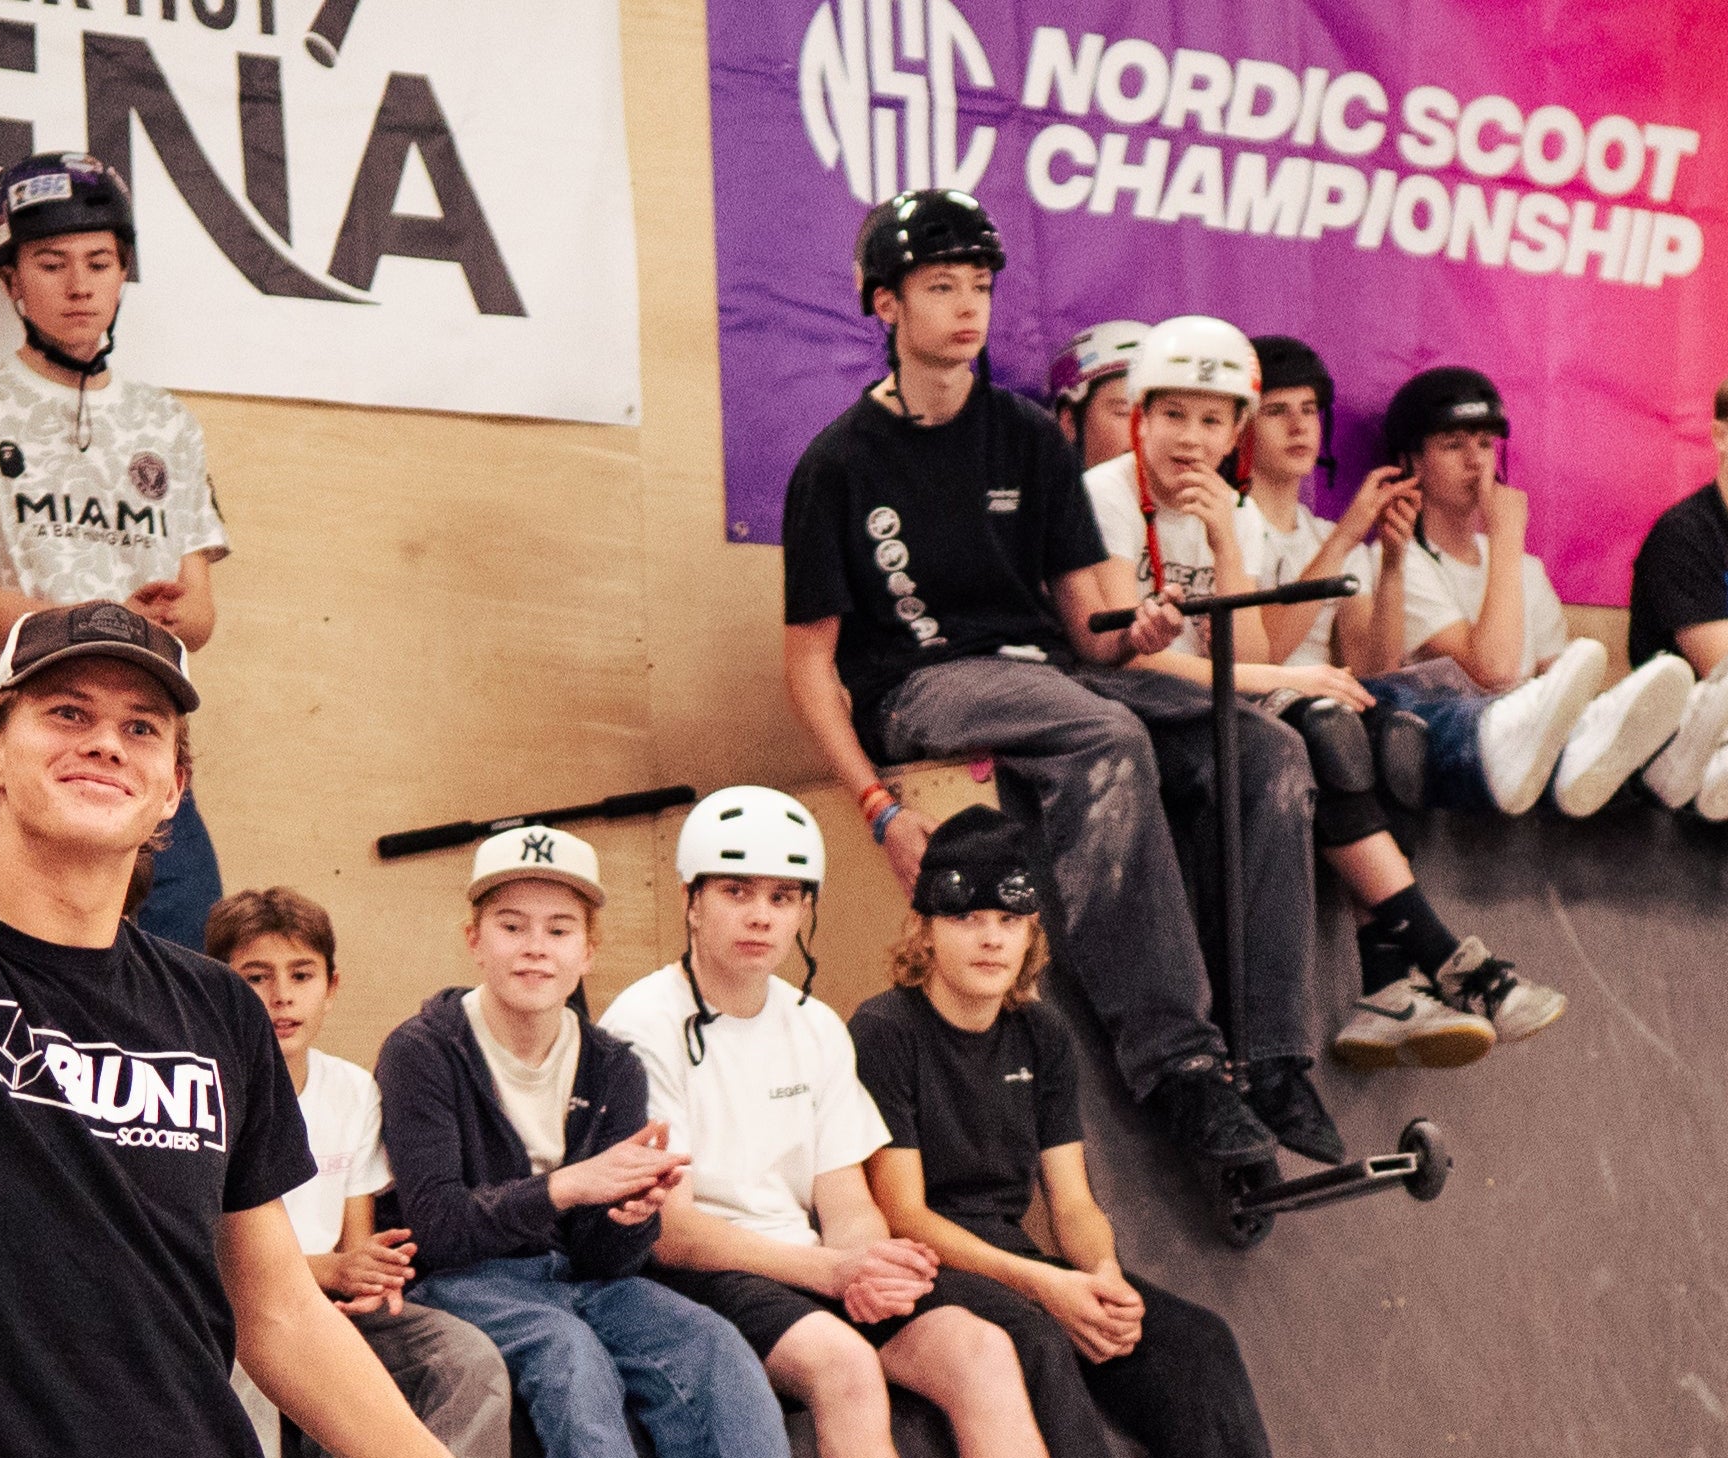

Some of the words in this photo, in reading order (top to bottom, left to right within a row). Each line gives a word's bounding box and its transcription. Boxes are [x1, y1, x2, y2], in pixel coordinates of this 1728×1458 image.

[799, 0, 997, 206] NSC
[1022, 25, 1389, 157] NORDIC
[1398, 84, 1701, 203] SCOOT
[1024, 123, 1706, 289] CHAMPIONSHIP
[14, 492, 168, 538] MIAMI
[520, 832, 555, 863] NY
[115, 1126, 201, 1151] SCOOTERS
